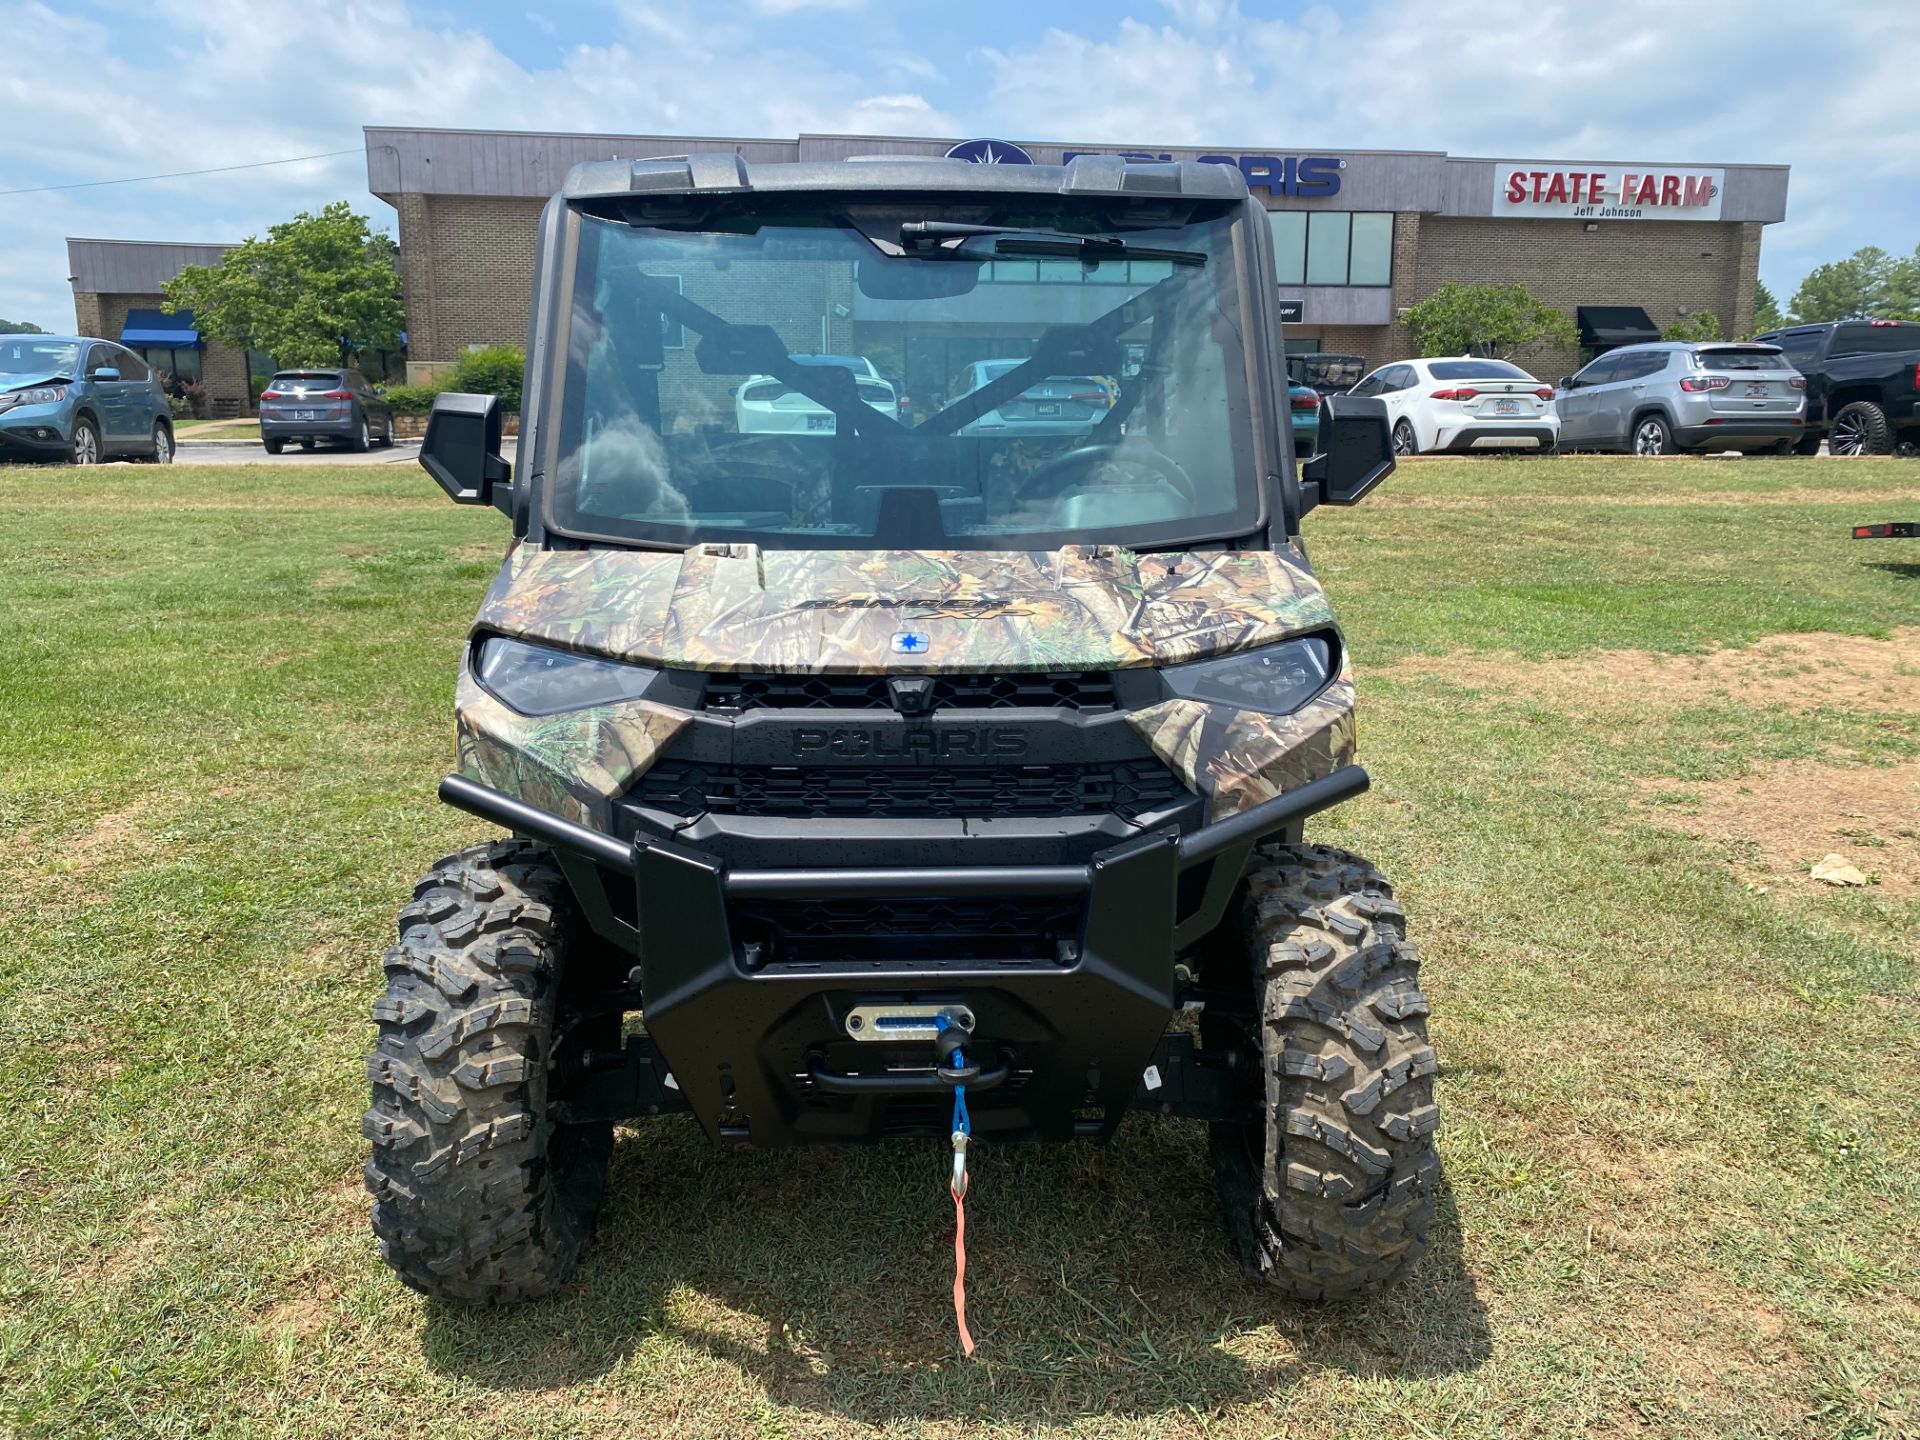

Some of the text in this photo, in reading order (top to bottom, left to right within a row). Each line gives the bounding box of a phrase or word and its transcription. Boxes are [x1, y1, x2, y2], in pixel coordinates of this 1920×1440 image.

[1506, 171, 1713, 207] STATE FARM
[1574, 206, 1642, 217] Jeff Johnson
[793, 599, 1012, 610] RANGER
[905, 608, 1036, 620] XP
[792, 729, 1028, 757] POLARIS
